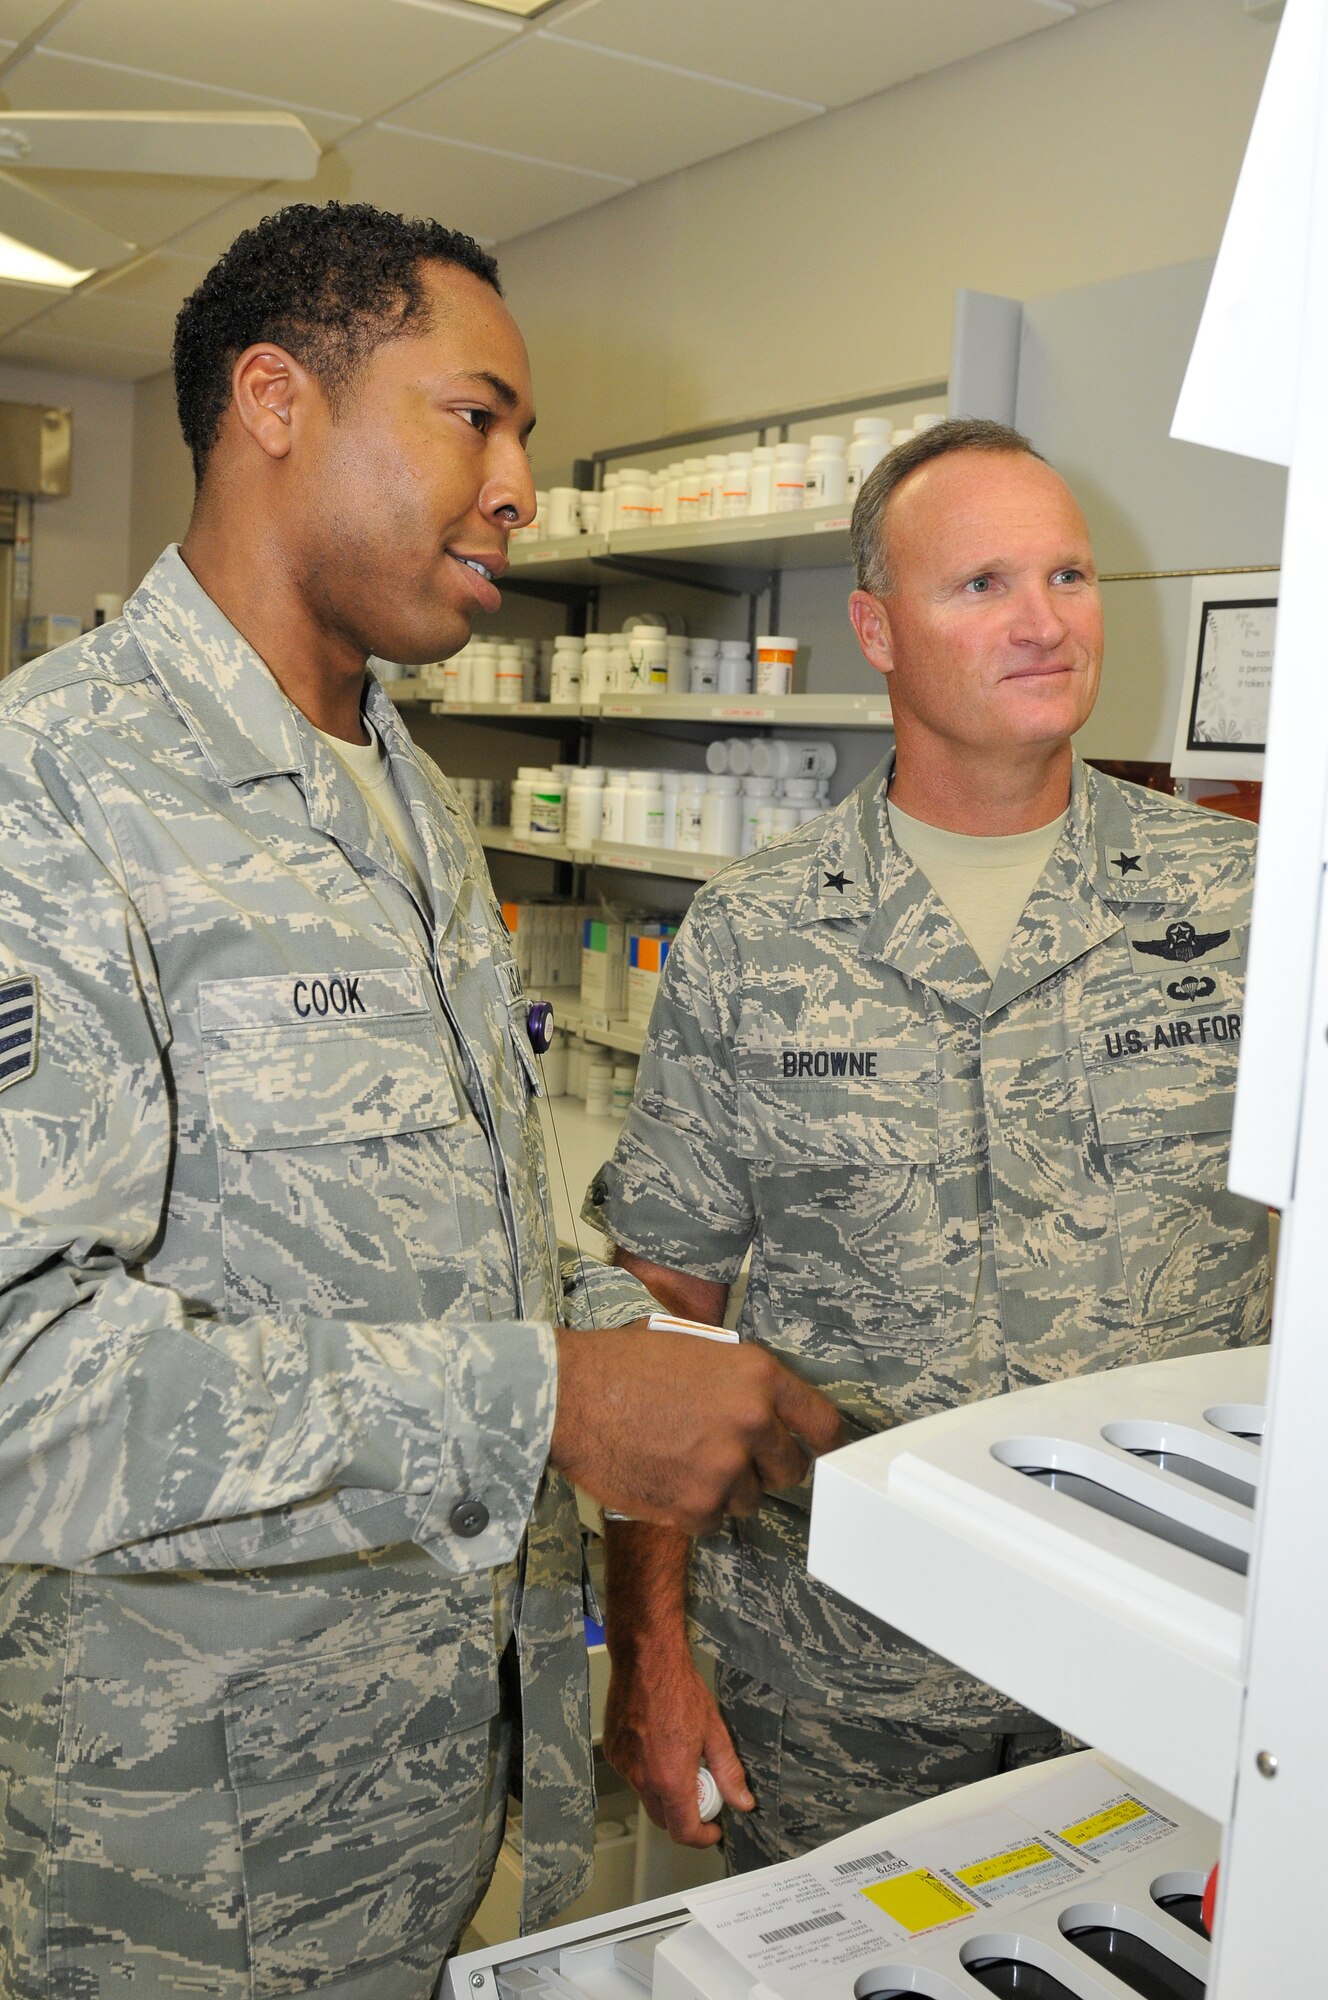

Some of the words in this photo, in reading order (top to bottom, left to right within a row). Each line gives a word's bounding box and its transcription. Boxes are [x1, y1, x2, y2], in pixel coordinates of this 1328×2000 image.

[1241, 648, 1255, 658] You
[293, 977, 366, 1017] COOK
[1104, 1029, 1148, 1059] U.S.
[1154, 1020, 1194, 1050] AIR
[1198, 1013, 1242, 1044] FOR
[782, 1050, 878, 1078] BROWNE
[875, 1859, 909, 1875] D5379
